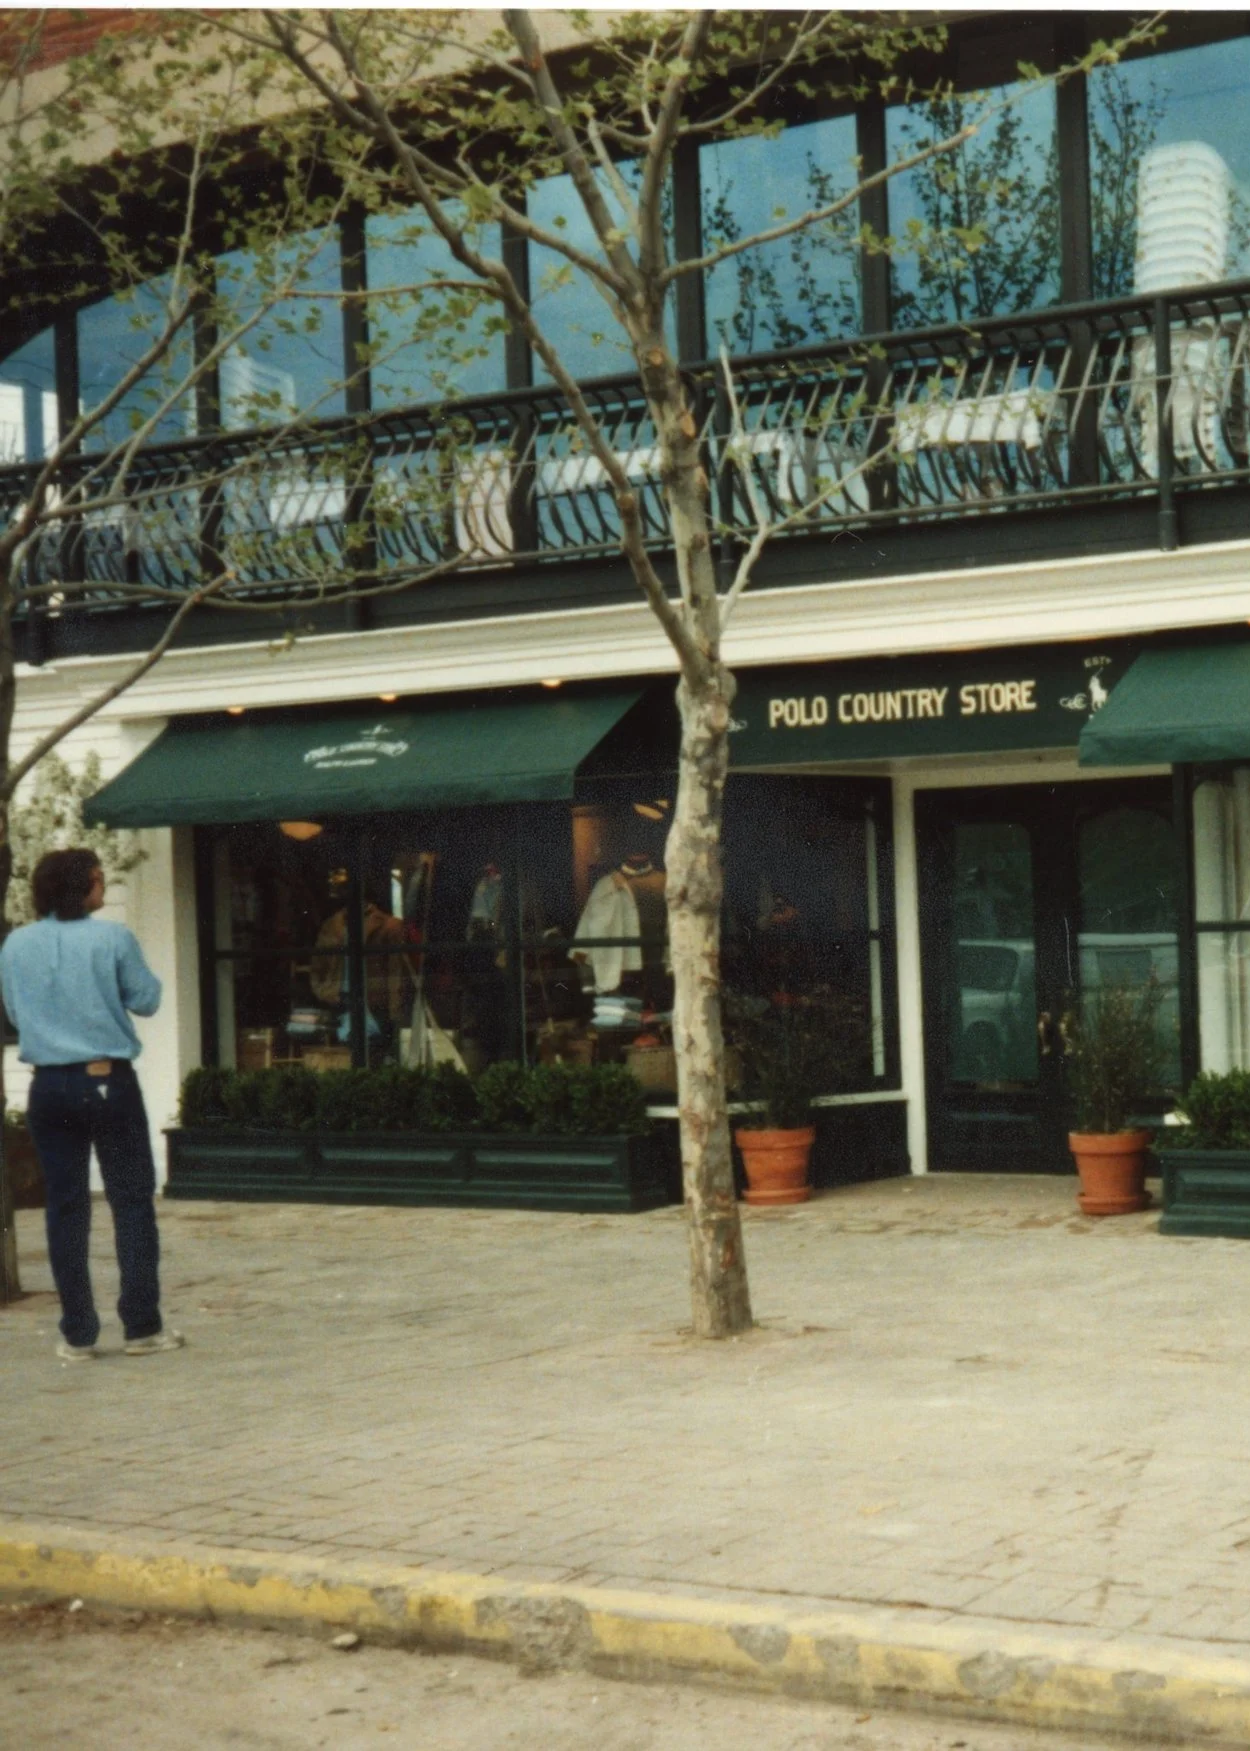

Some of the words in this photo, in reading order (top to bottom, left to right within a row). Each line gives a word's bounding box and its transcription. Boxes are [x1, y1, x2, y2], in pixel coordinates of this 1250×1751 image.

[768, 696, 828, 728] POLO
[838, 687, 949, 723] COUNTRY
[960, 680, 1037, 716] STORE
